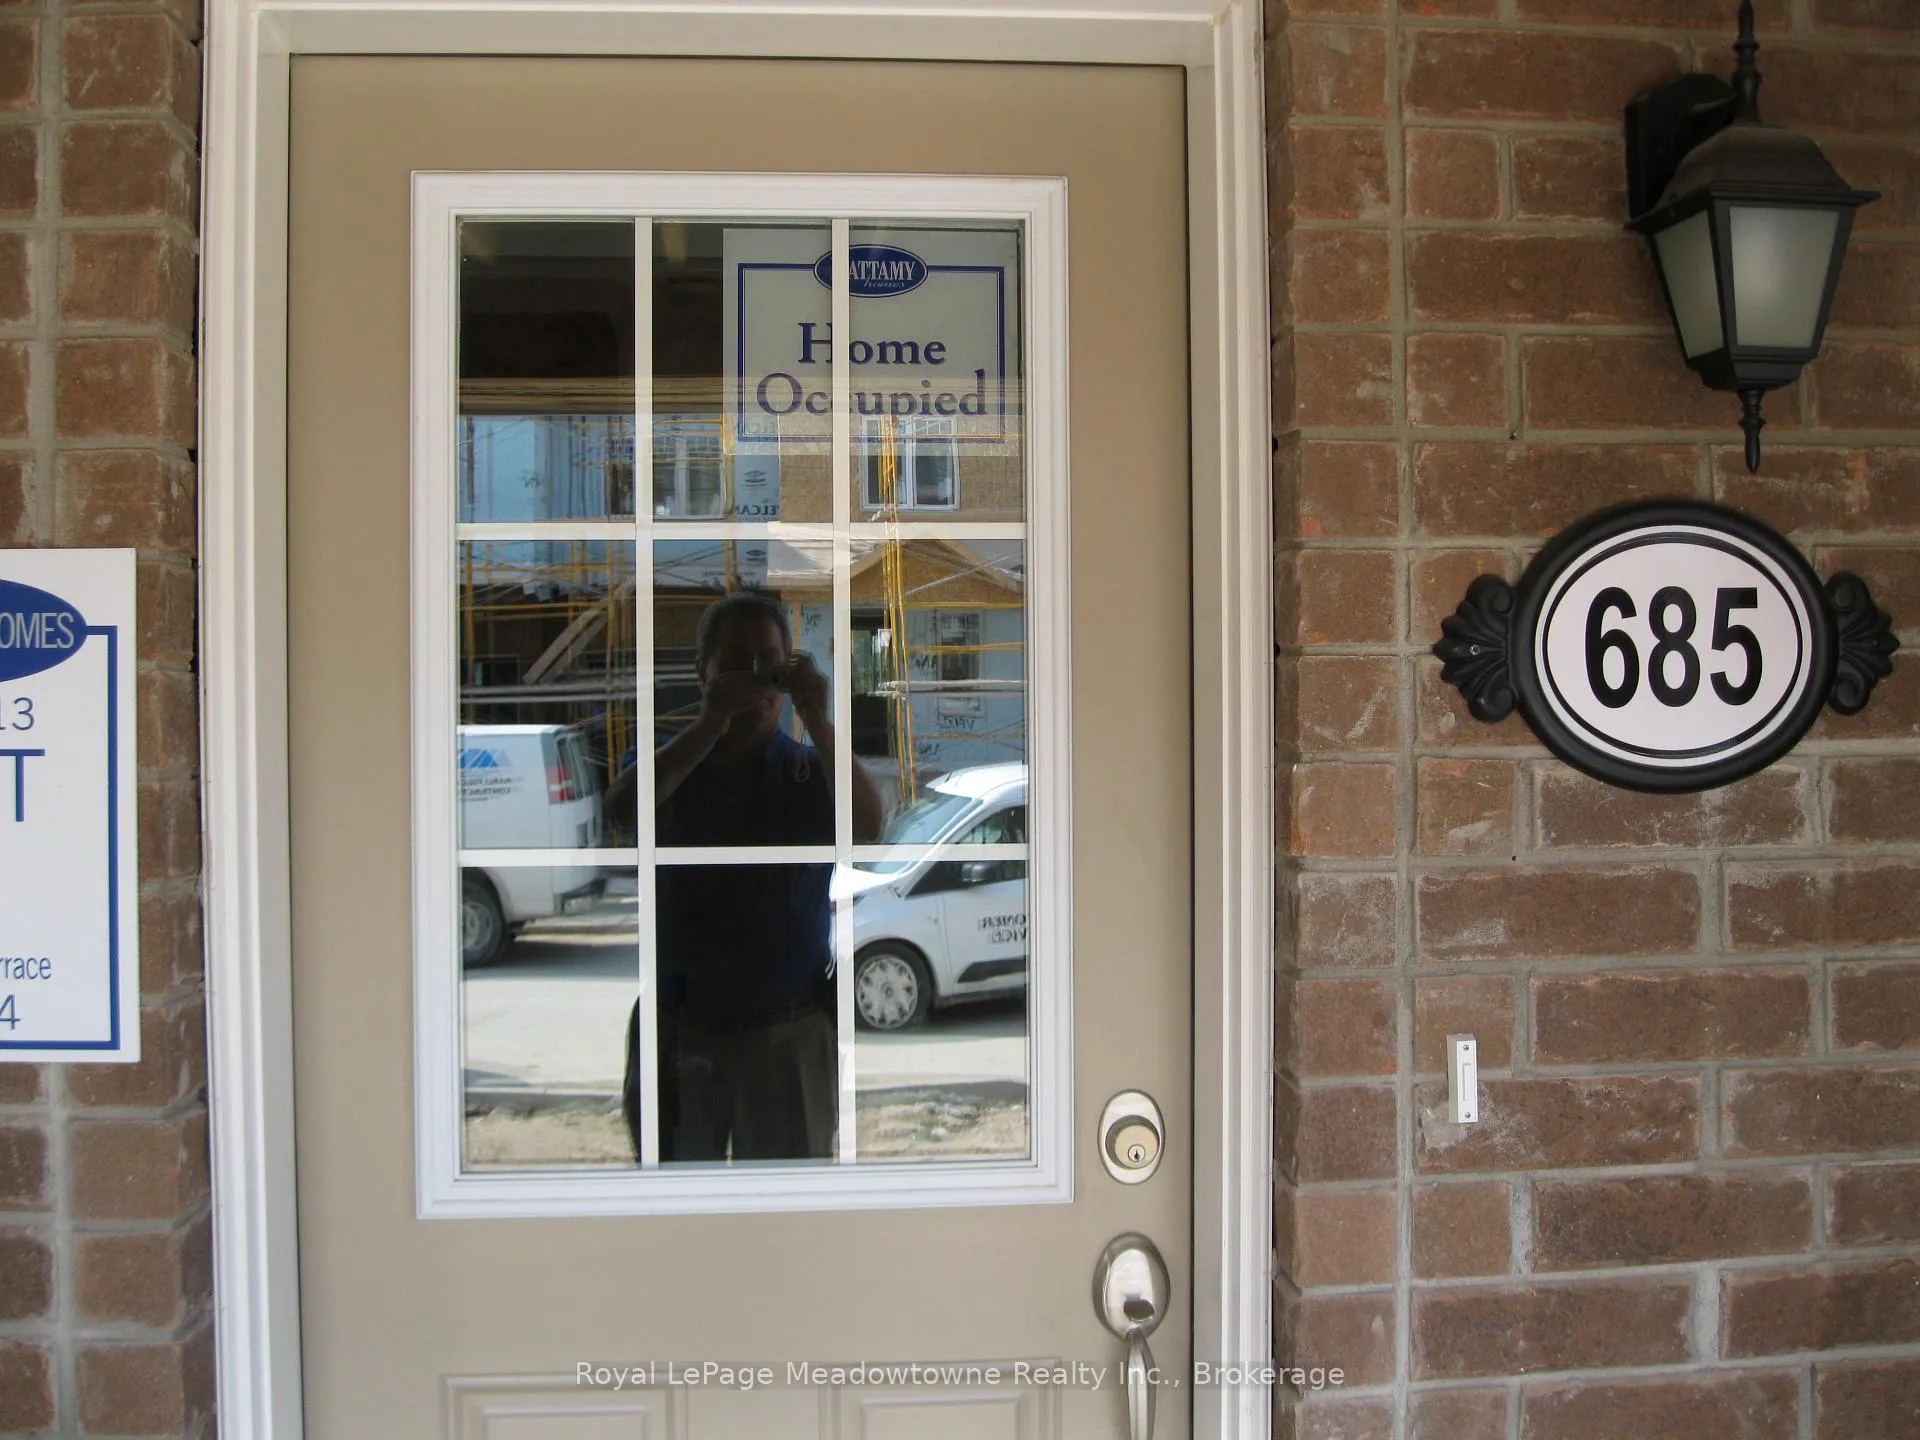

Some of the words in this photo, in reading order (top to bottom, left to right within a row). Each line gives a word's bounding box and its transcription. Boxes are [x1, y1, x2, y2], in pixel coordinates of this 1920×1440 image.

[848, 260, 916, 281] ATTAMY
[797, 321, 947, 365] Home
[0, 611, 75, 649] OMES
[1585, 586, 1763, 708] 685
